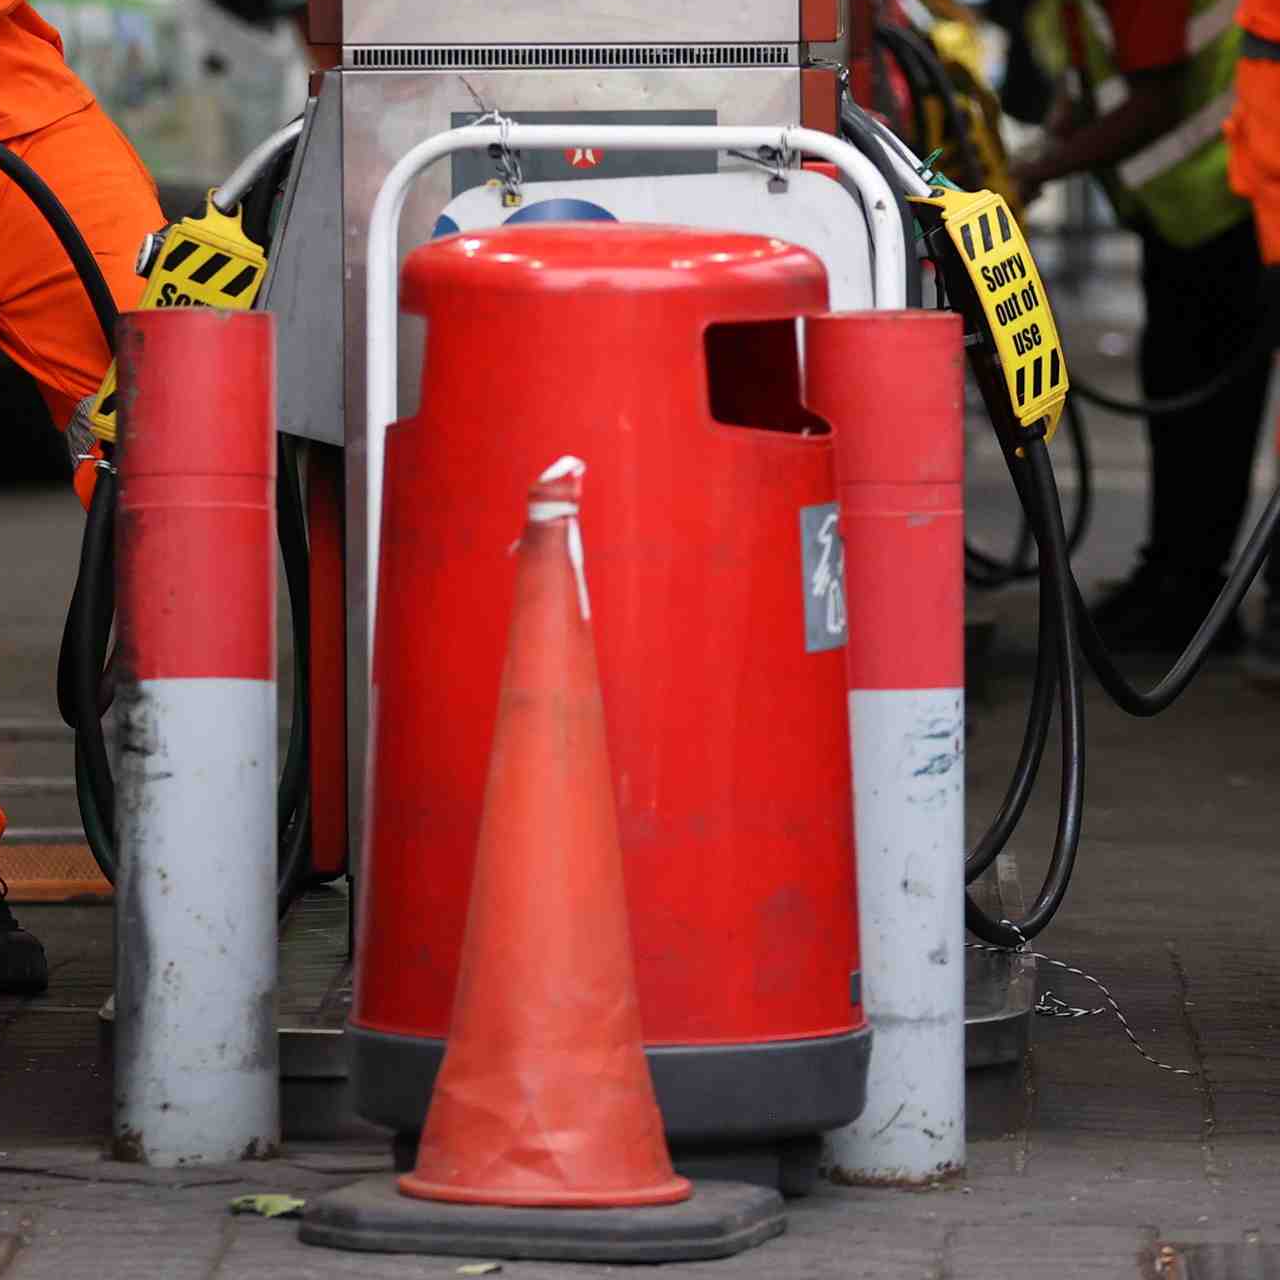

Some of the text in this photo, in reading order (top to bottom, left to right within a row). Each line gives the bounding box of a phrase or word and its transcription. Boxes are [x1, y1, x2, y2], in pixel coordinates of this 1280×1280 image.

[981, 253, 1026, 292] Sorry
[995, 280, 1040, 327] out of
[1011, 322, 1042, 357] use
